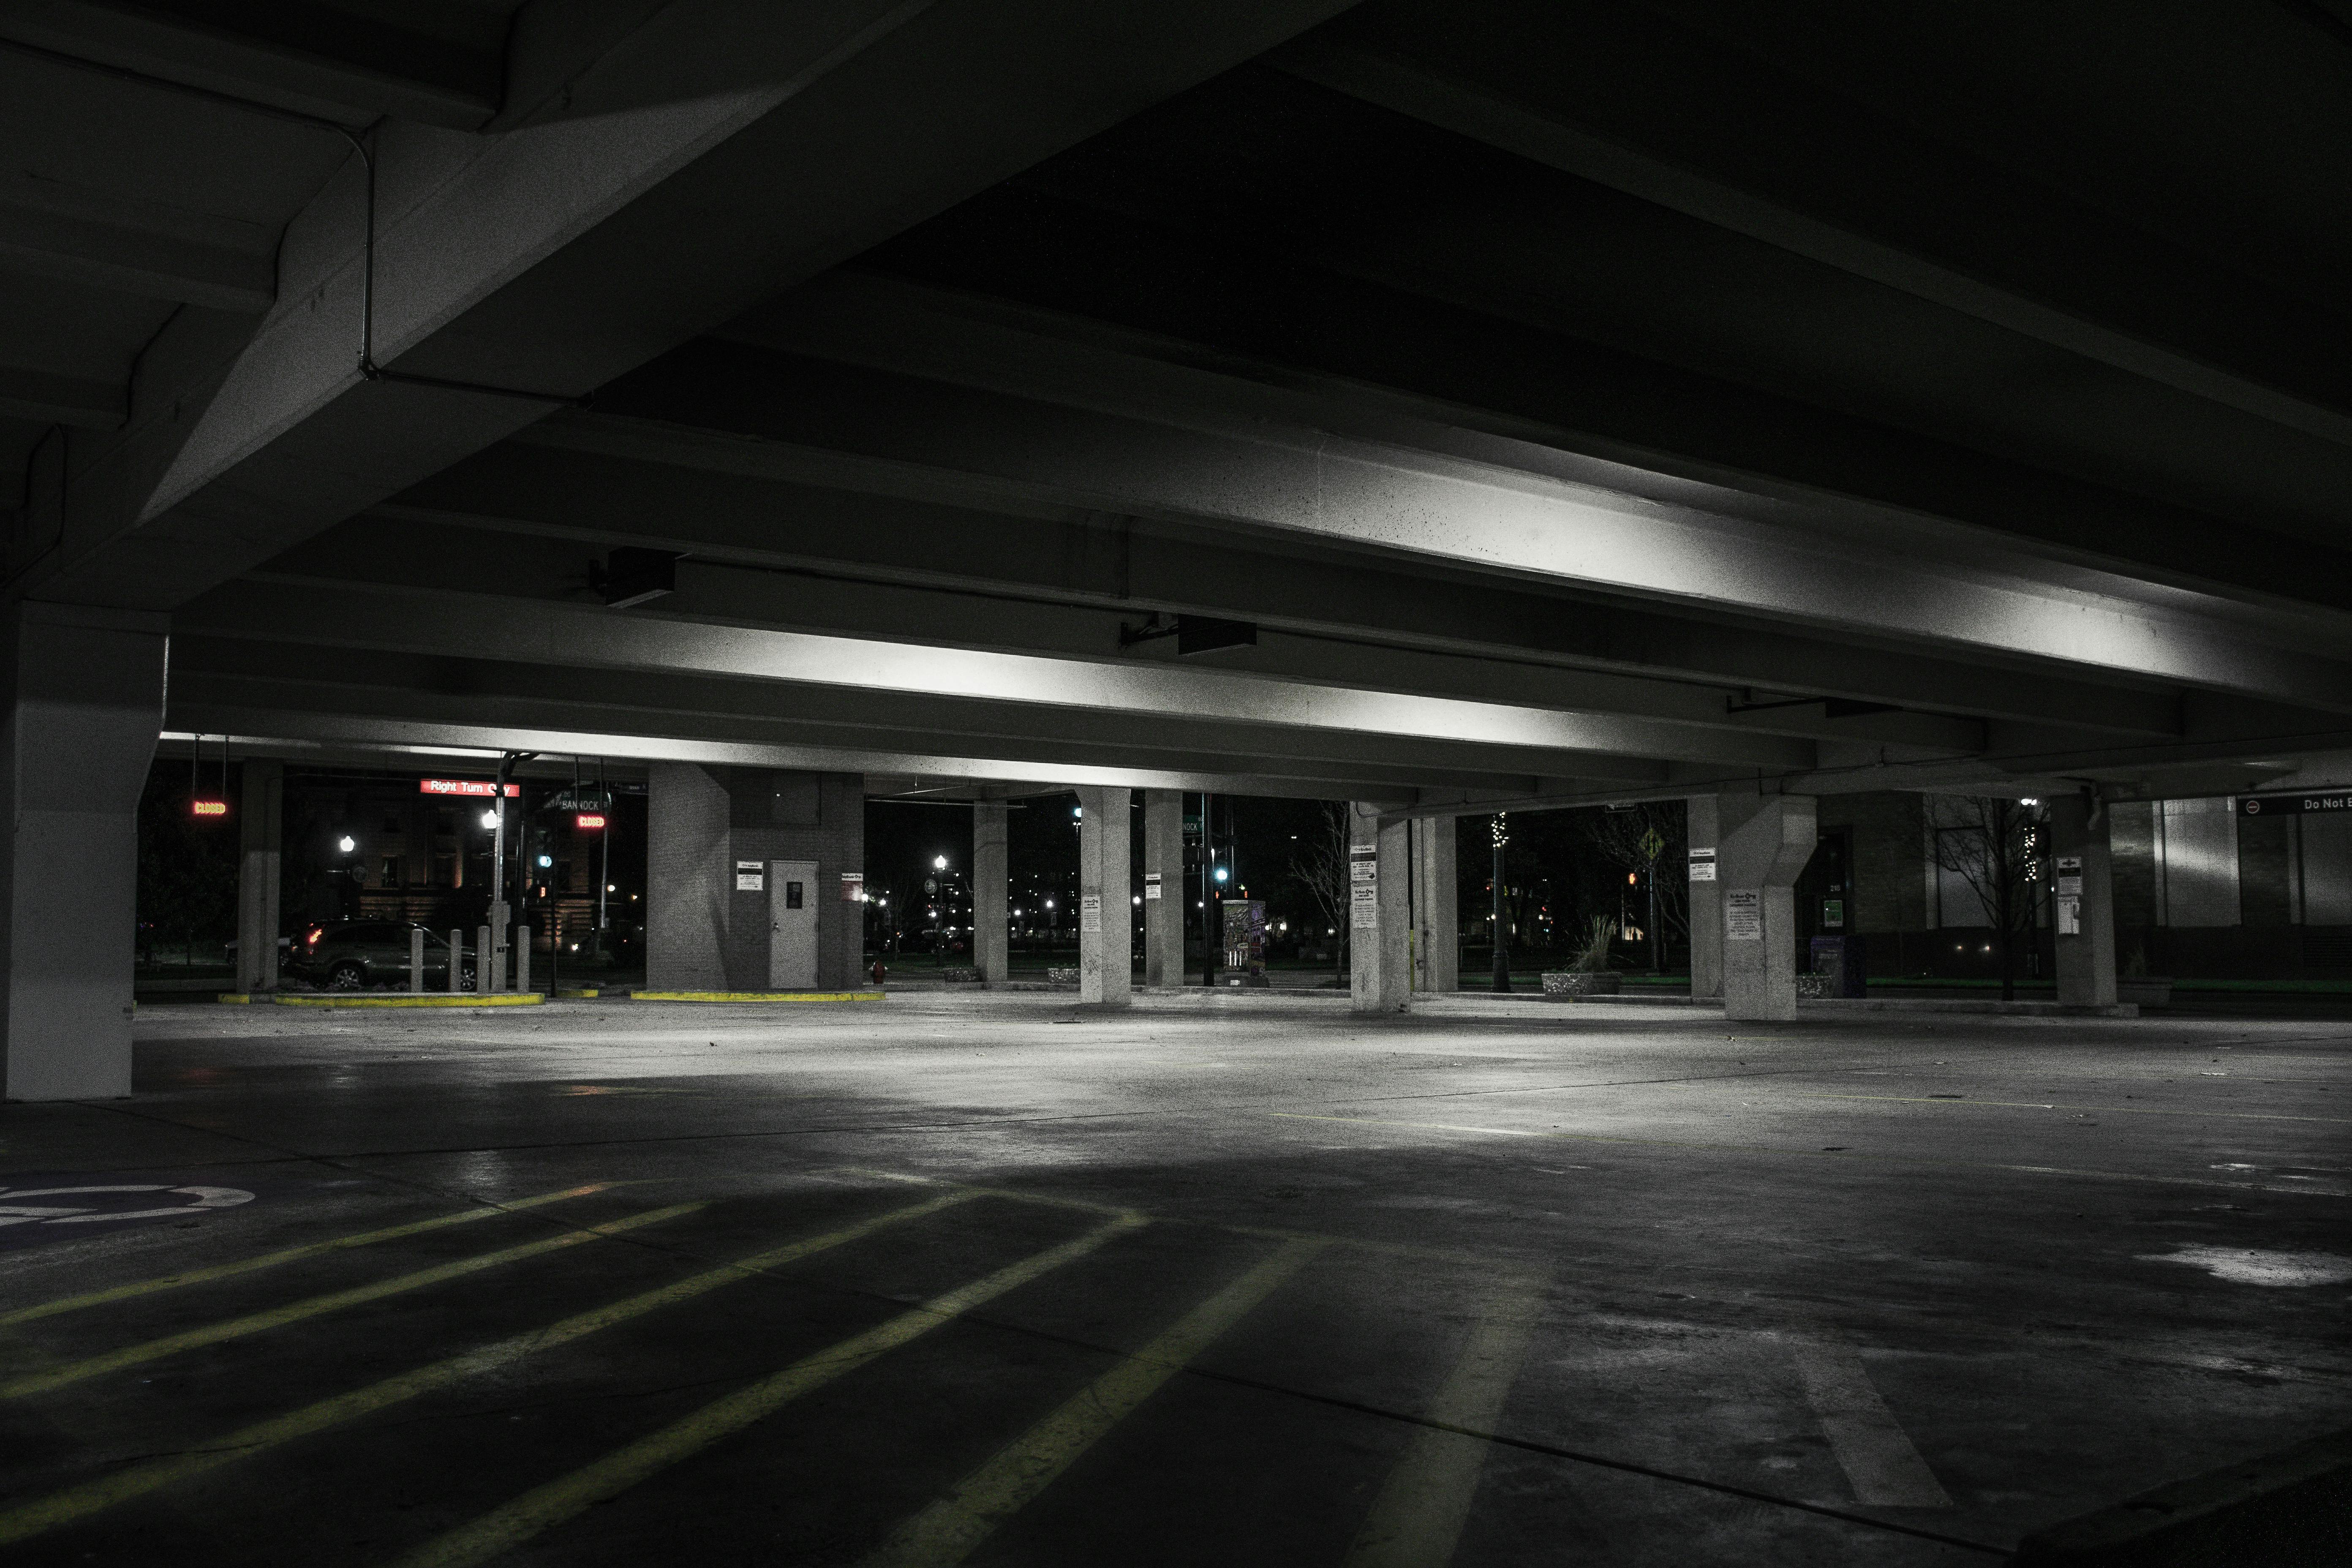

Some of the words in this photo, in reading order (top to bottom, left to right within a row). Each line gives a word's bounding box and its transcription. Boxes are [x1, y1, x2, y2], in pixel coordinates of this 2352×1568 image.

[430, 780, 457, 793] Right
[461, 782, 483, 793] Turn
[487, 783, 511, 796] Oy
[196, 803, 226, 814] CLOSED
[2304, 799, 2319, 809] Do
[2322, 798, 2344, 808] Not
[579, 816, 604, 827] CLOSED
